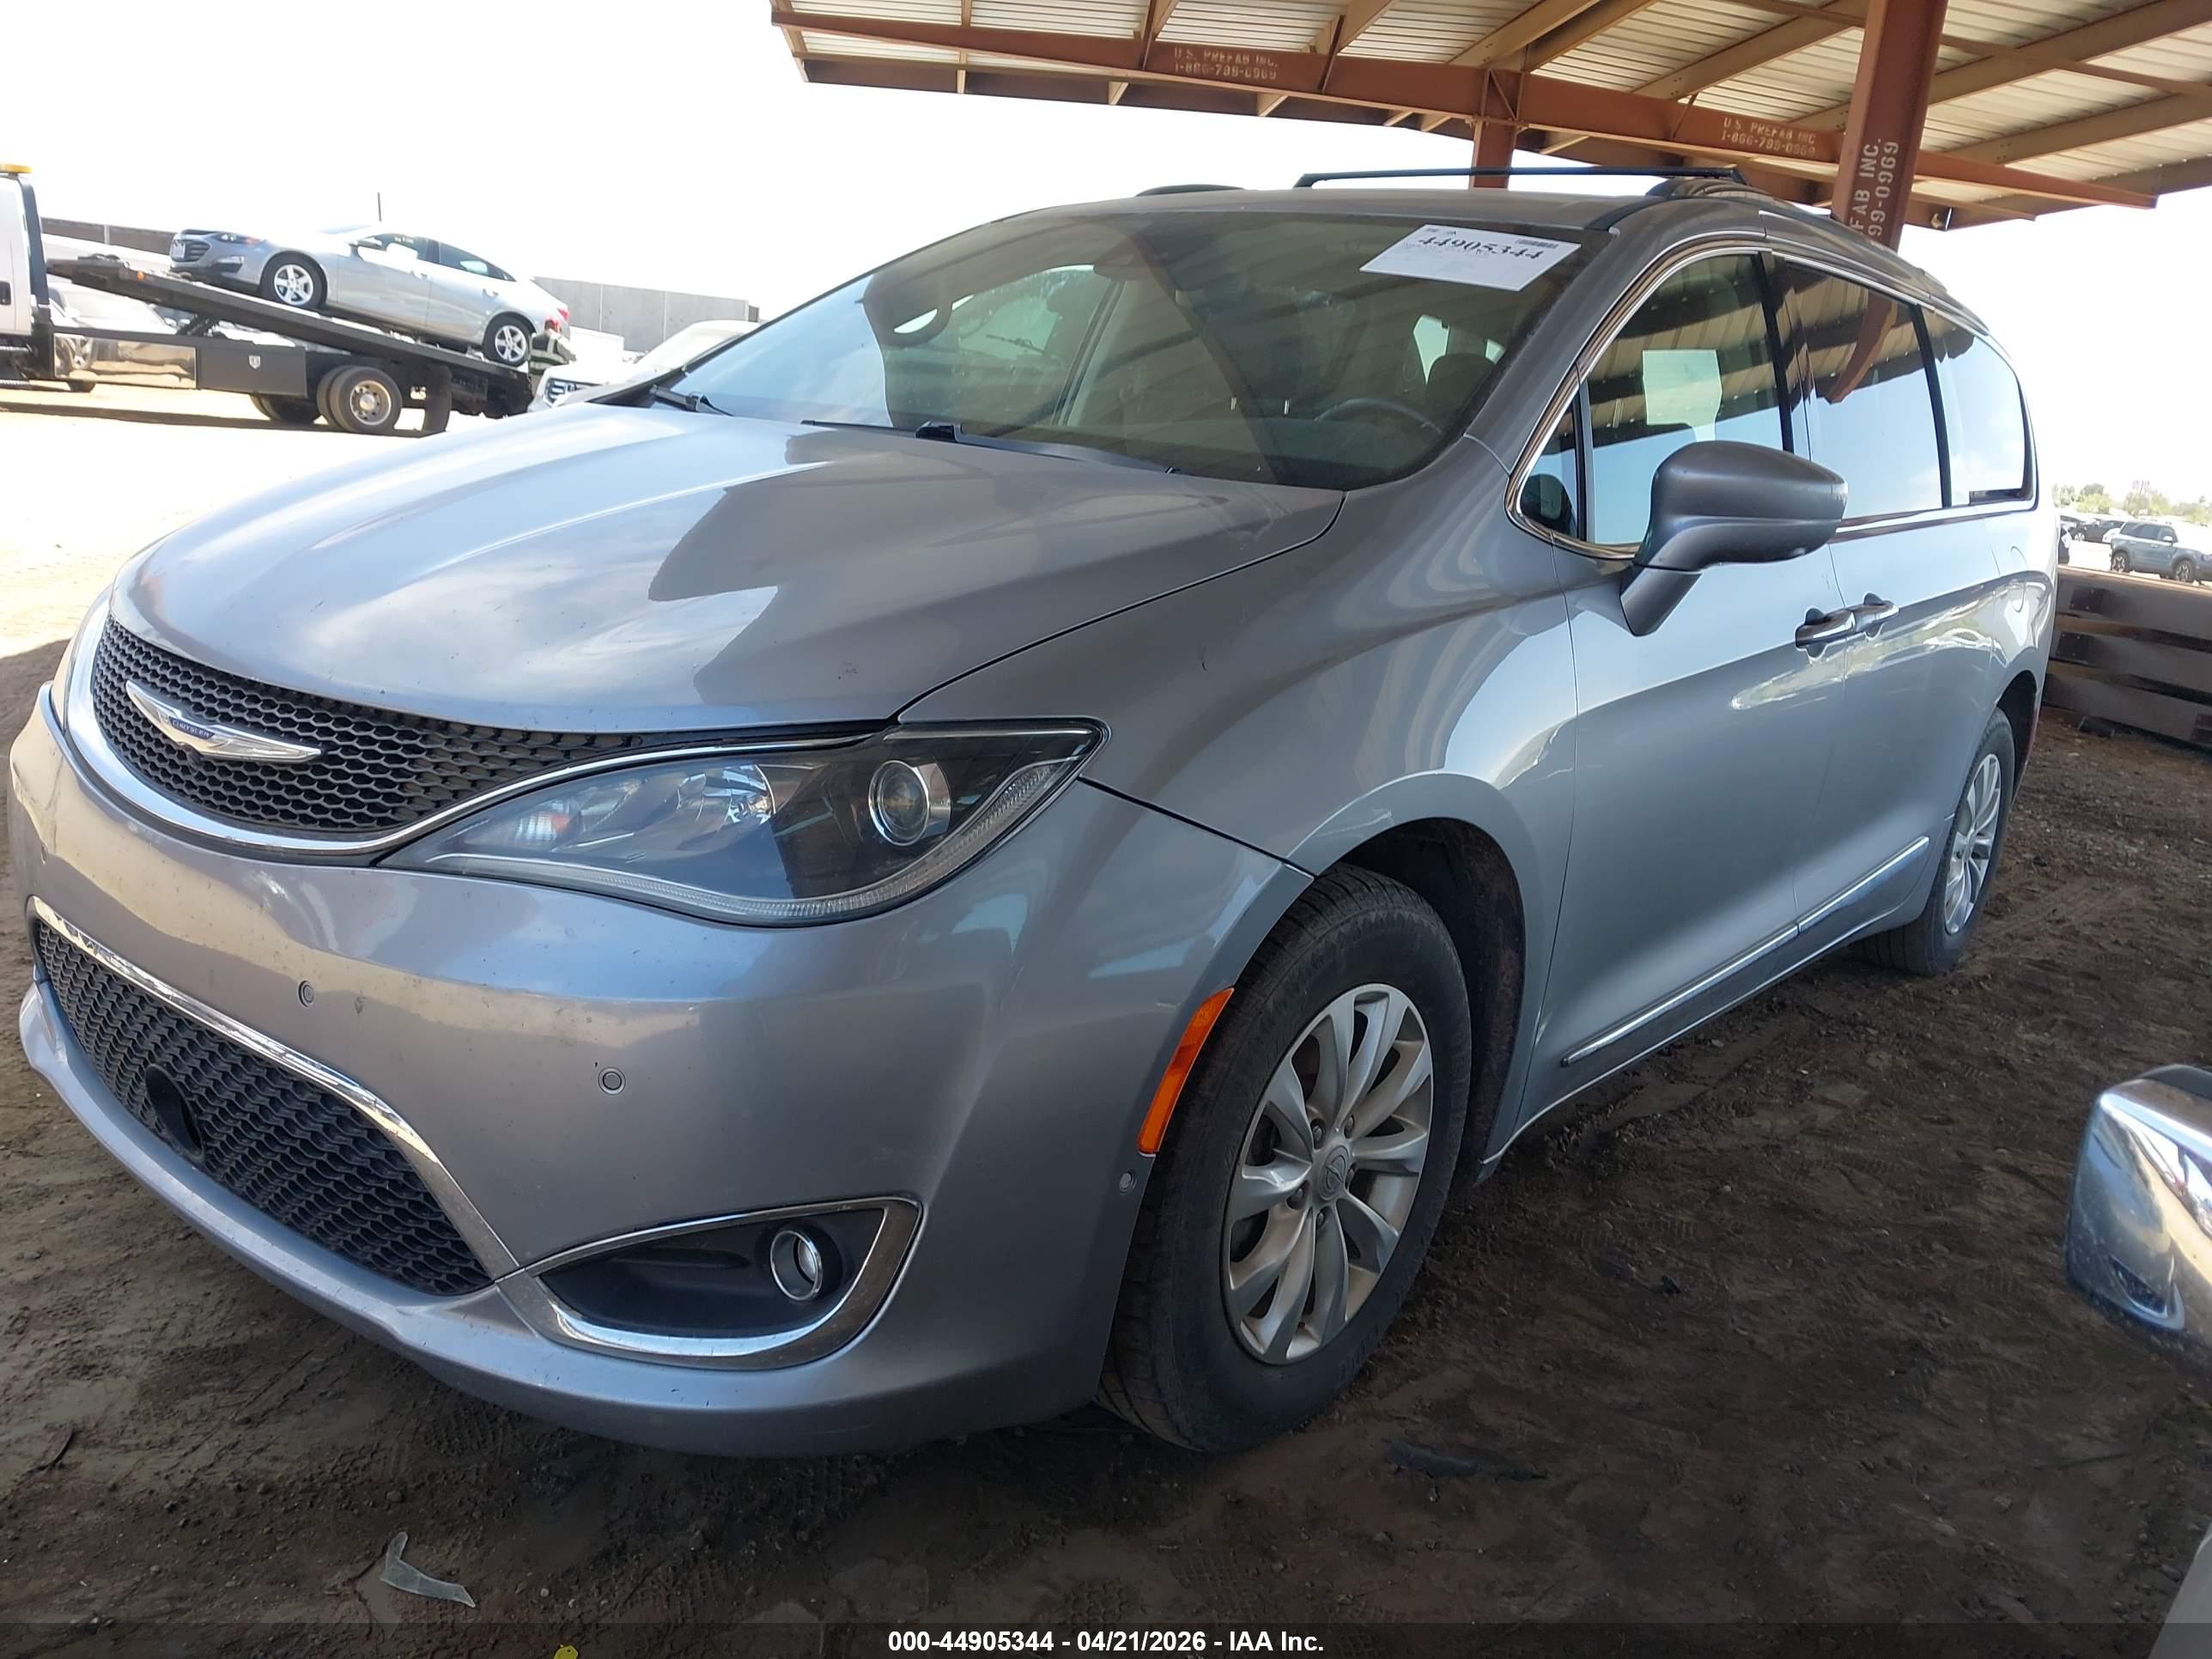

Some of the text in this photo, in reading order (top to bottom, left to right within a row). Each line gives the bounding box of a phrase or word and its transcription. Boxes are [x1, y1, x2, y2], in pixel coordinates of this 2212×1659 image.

[1203, 49, 1250, 65] PREFAB
[1750, 122, 1793, 140] PREFAB
[1858, 138, 1881, 179] INC.
[1418, 236, 1545, 259] 44905344
[172, 720, 210, 738] CHRYSLER
